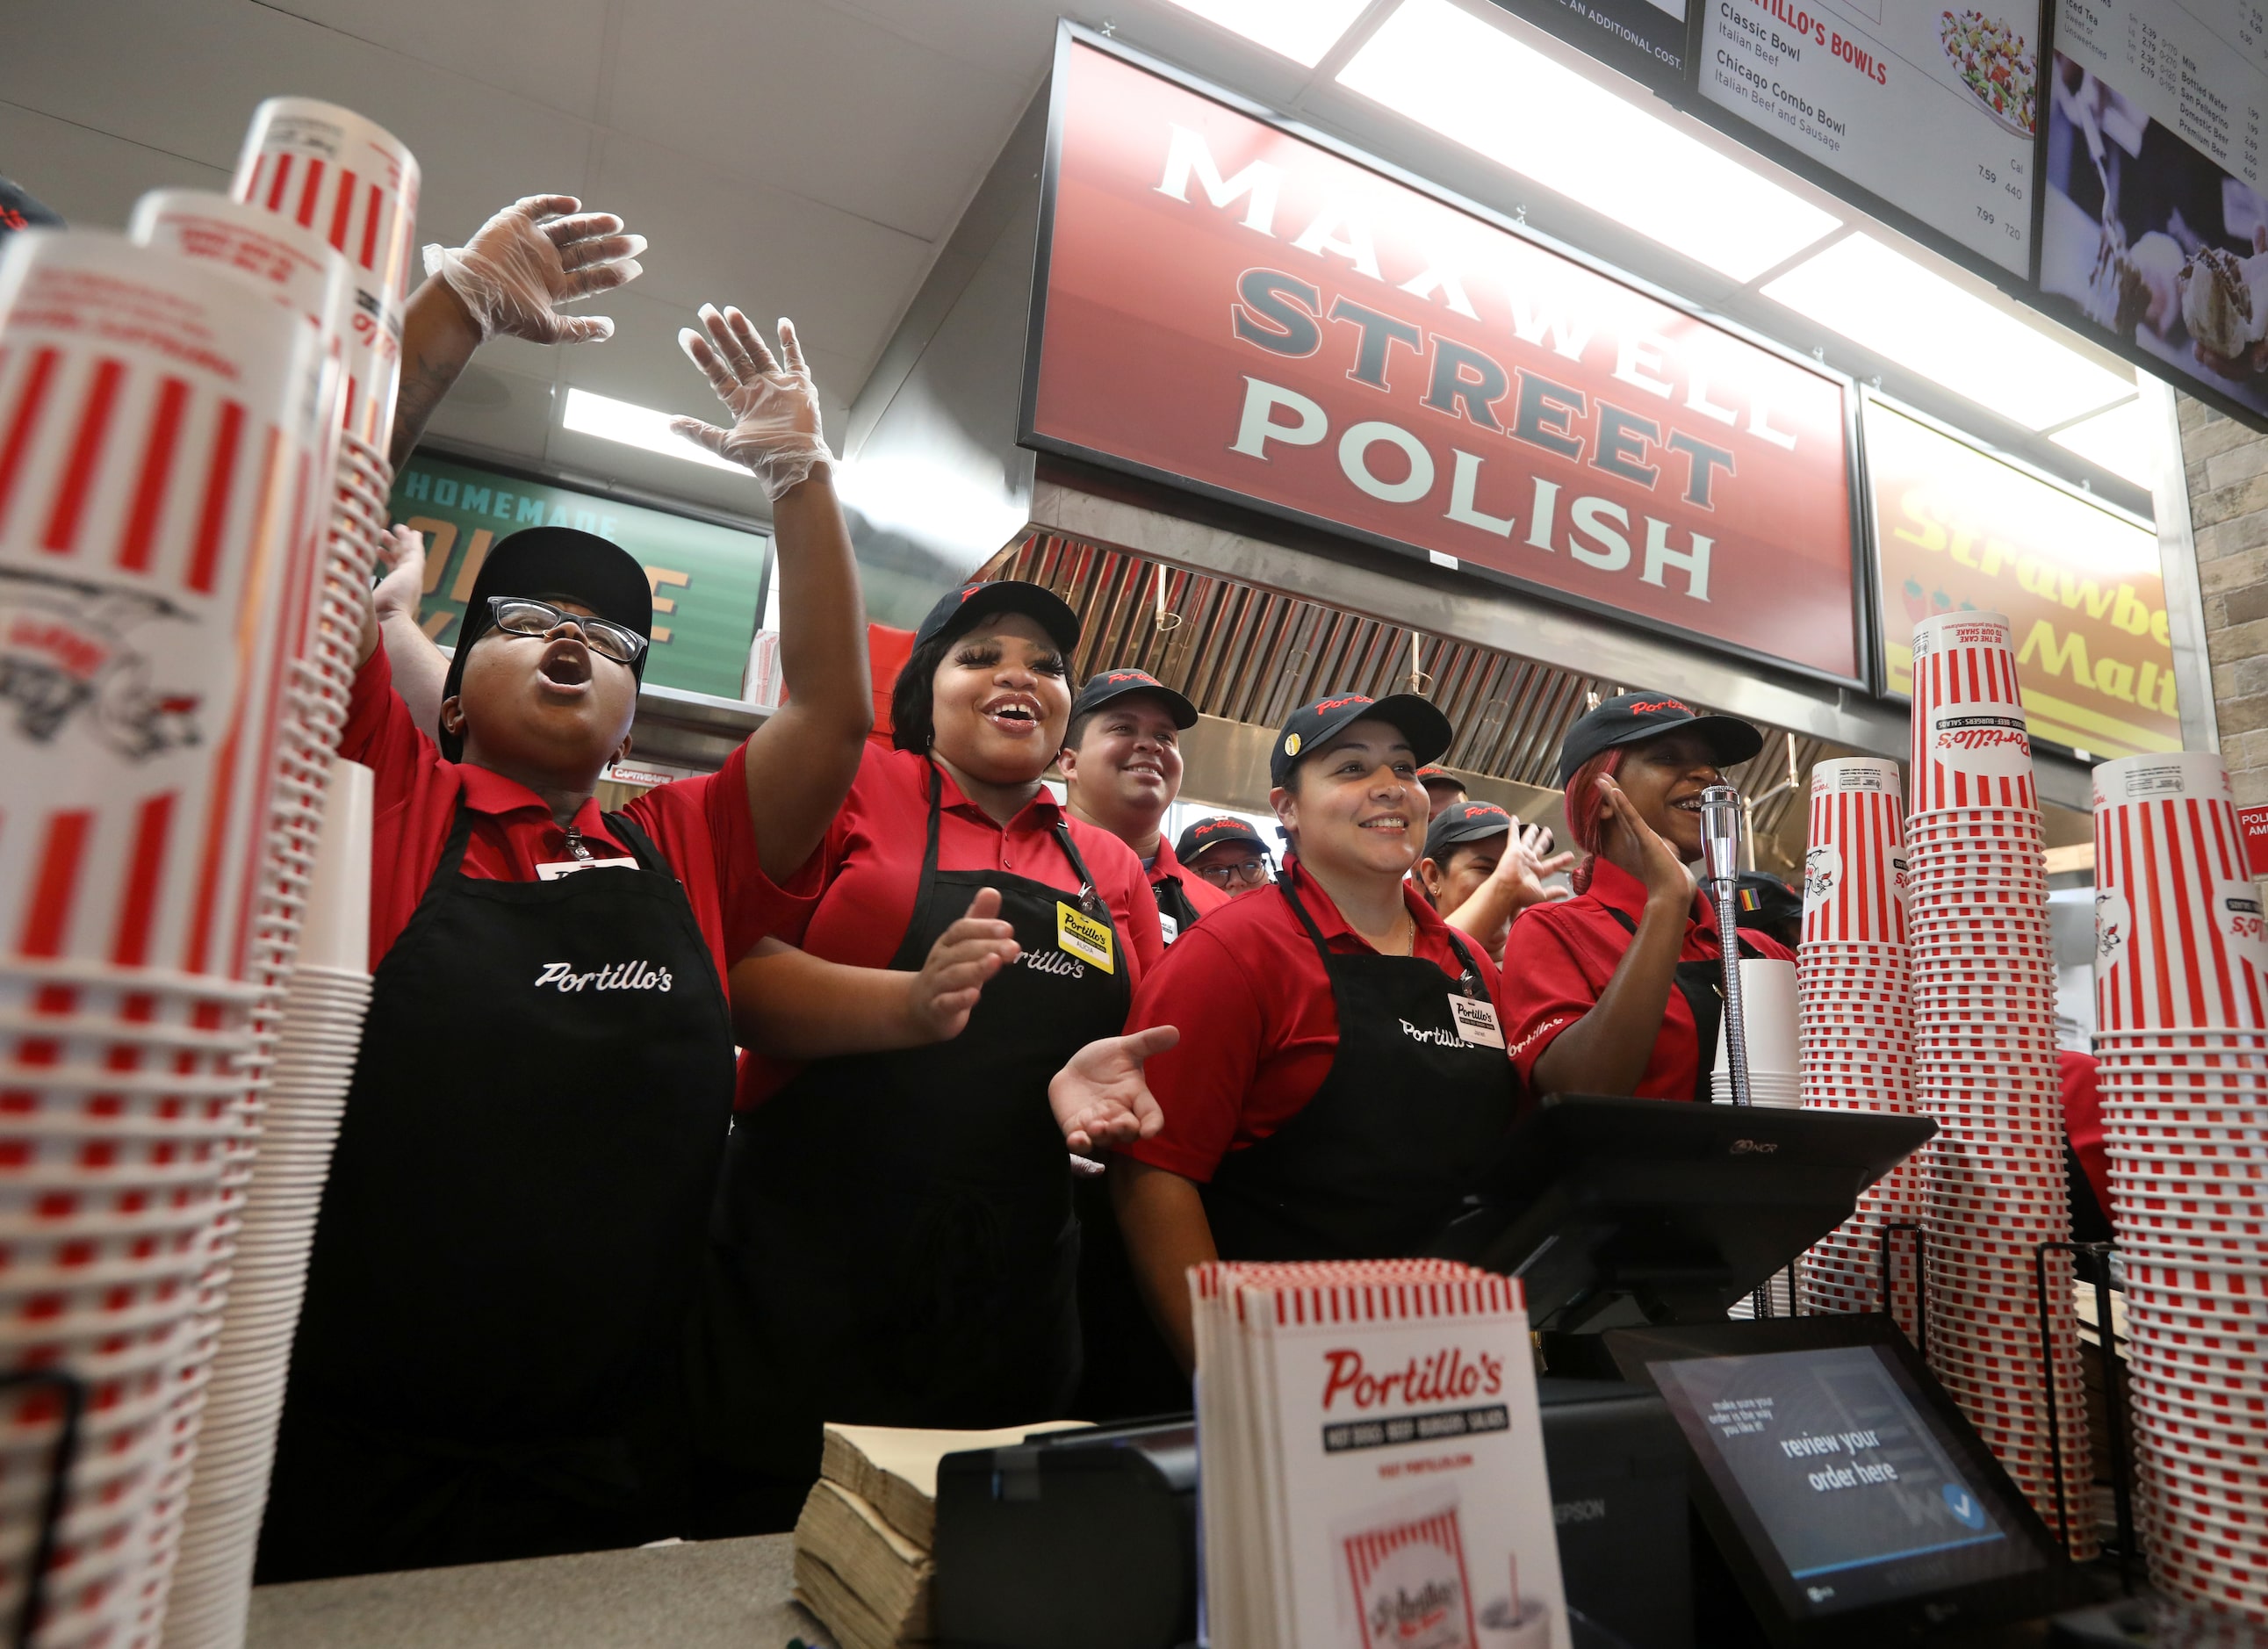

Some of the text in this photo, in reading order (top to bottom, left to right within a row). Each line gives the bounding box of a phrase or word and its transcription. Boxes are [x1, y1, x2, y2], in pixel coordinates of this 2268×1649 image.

[1721, 3, 1800, 61] Classic Bowl
[2065, 10, 2084, 29] Sweet
[2084, 8, 2098, 25] Tea
[2142, 24, 2156, 40] 2.39
[1569, 0, 1681, 70] AN ADDITIONAL COST.
[1718, 22, 1779, 67] Italian Beef
[2065, 24, 2107, 60] Unsweetened
[2142, 37, 2156, 52] 2.79
[1831, 32, 1887, 85] BOWLS
[2141, 50, 2155, 66] 2.39
[2141, 63, 2155, 78] 2.79
[2183, 56, 2196, 73] Milk
[1717, 49, 1846, 136] Chicago Combo Bowl
[2182, 72, 2207, 97] Bottled
[2208, 92, 2228, 112] Water
[1715, 69, 1840, 151] Italian Beef and Sausage
[2180, 103, 2212, 133] Domestic
[2214, 127, 2228, 145] Beer
[2181, 88, 2194, 104] San
[2196, 100, 2228, 129] Pellegrino
[2179, 119, 2209, 148] Premium
[2212, 143, 2227, 160] Beer
[1978, 164, 2022, 200] 7.59 440
[2011, 159, 2023, 175] Cal
[1976, 206, 2020, 241] 7.99 720
[1231, 266, 1737, 512] STREET
[1228, 375, 1716, 603] POLISH
[1955, 627, 1980, 637] SHAKE
[1980, 635, 1993, 644] THE
[1981, 628, 1994, 637] OUR
[1965, 717, 1995, 726] BURGERS
[1938, 729, 2030, 757] Portillo's
[2242, 813, 2268, 824] POL
[2250, 825, 2268, 836] AM
[1065, 912, 1106, 945] Portillo's
[535, 960, 673, 992] Portillo's
[1013, 948, 1085, 979] rtillo's
[1457, 1003, 1493, 1023] Portillo's
[1508, 1018, 1564, 1057] ortillo's
[1321, 1348, 1502, 1410] Portillo's
[1709, 1410, 1732, 1424] order
[1739, 1409, 1754, 1421] the
[1754, 1408, 1774, 1421] way
[1754, 1397, 1775, 1408] your
[1722, 1425, 1739, 1437] you
[1739, 1421, 1755, 1434] like
[1781, 1429, 1881, 1458] review your
[1808, 1460, 1898, 1492] order here
